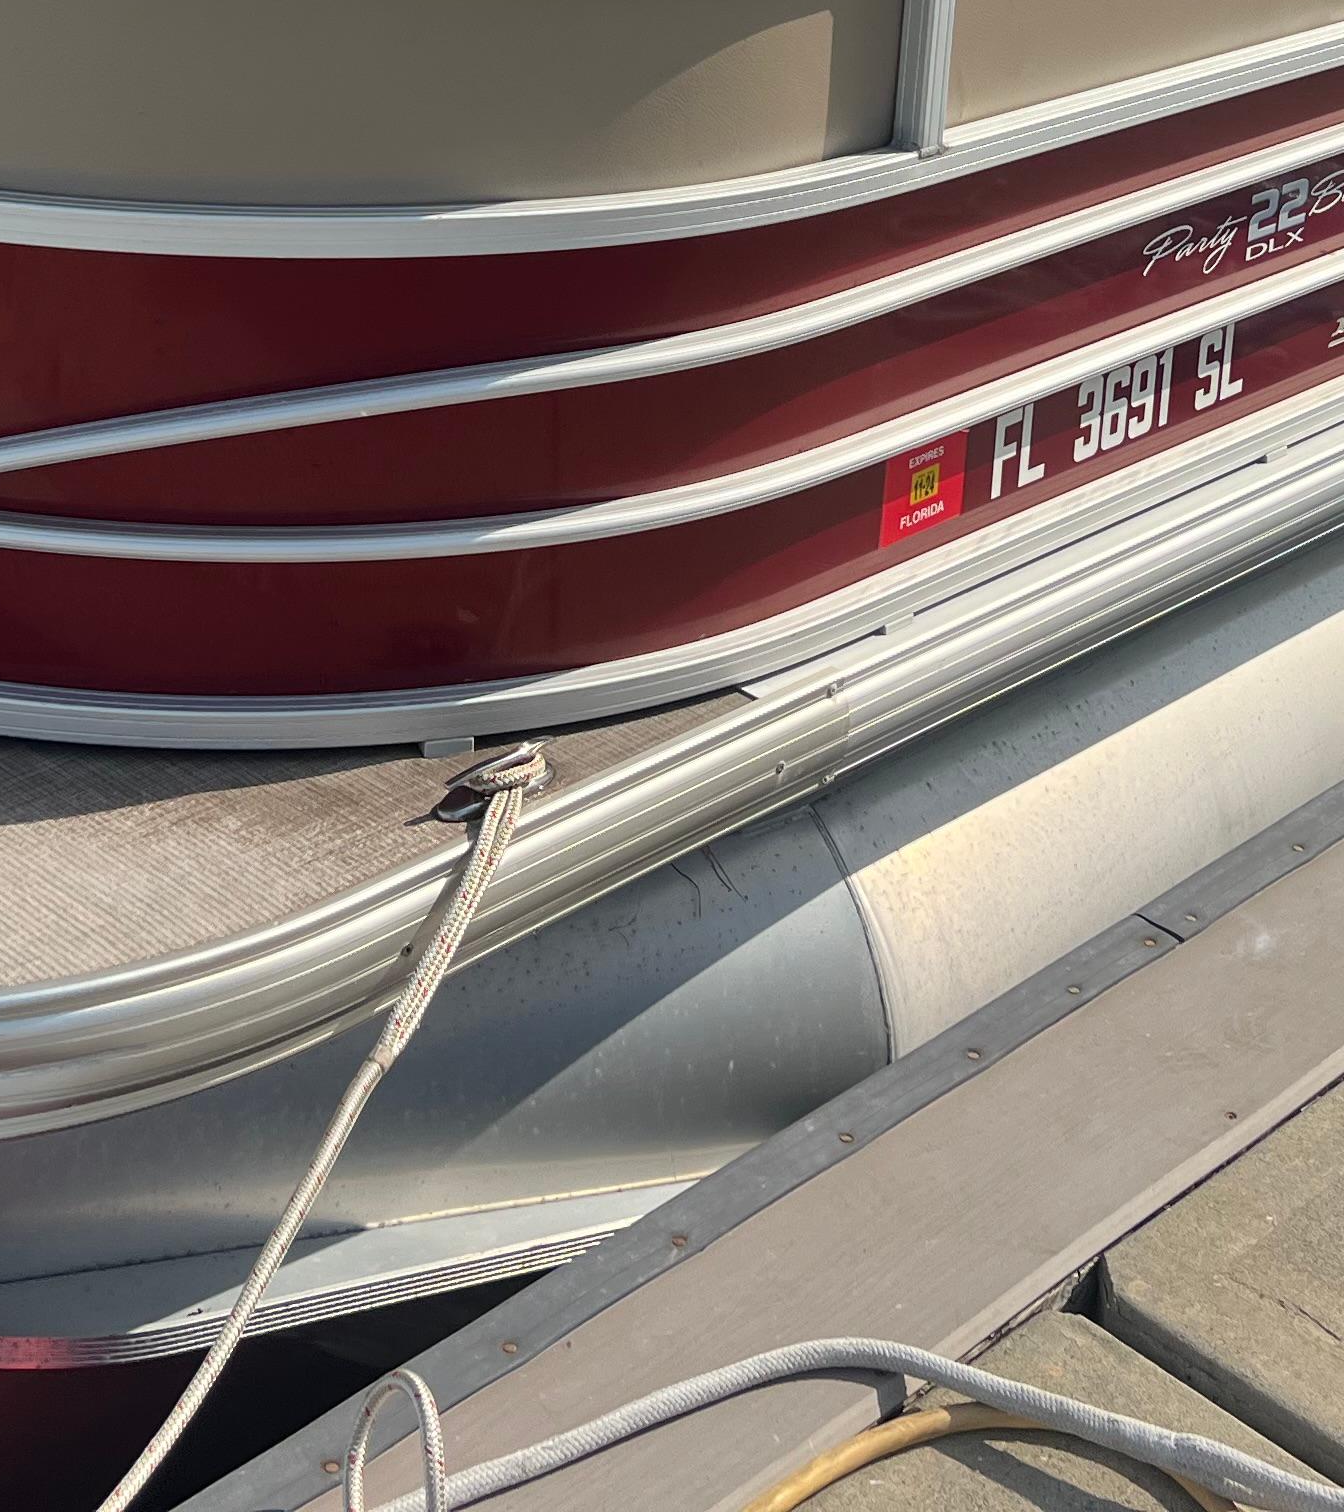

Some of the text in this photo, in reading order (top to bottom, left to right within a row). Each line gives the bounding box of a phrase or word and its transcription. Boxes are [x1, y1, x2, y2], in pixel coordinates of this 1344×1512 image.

[1142, 216, 1248, 277] Party
[1247, 178, 1310, 242] 22
[1245, 227, 1305, 262] DLX
[990, 322, 1244, 500] FL 3691 SL
[908, 445, 945, 470] EXPIRES
[899, 499, 945, 530] FLORIDA
